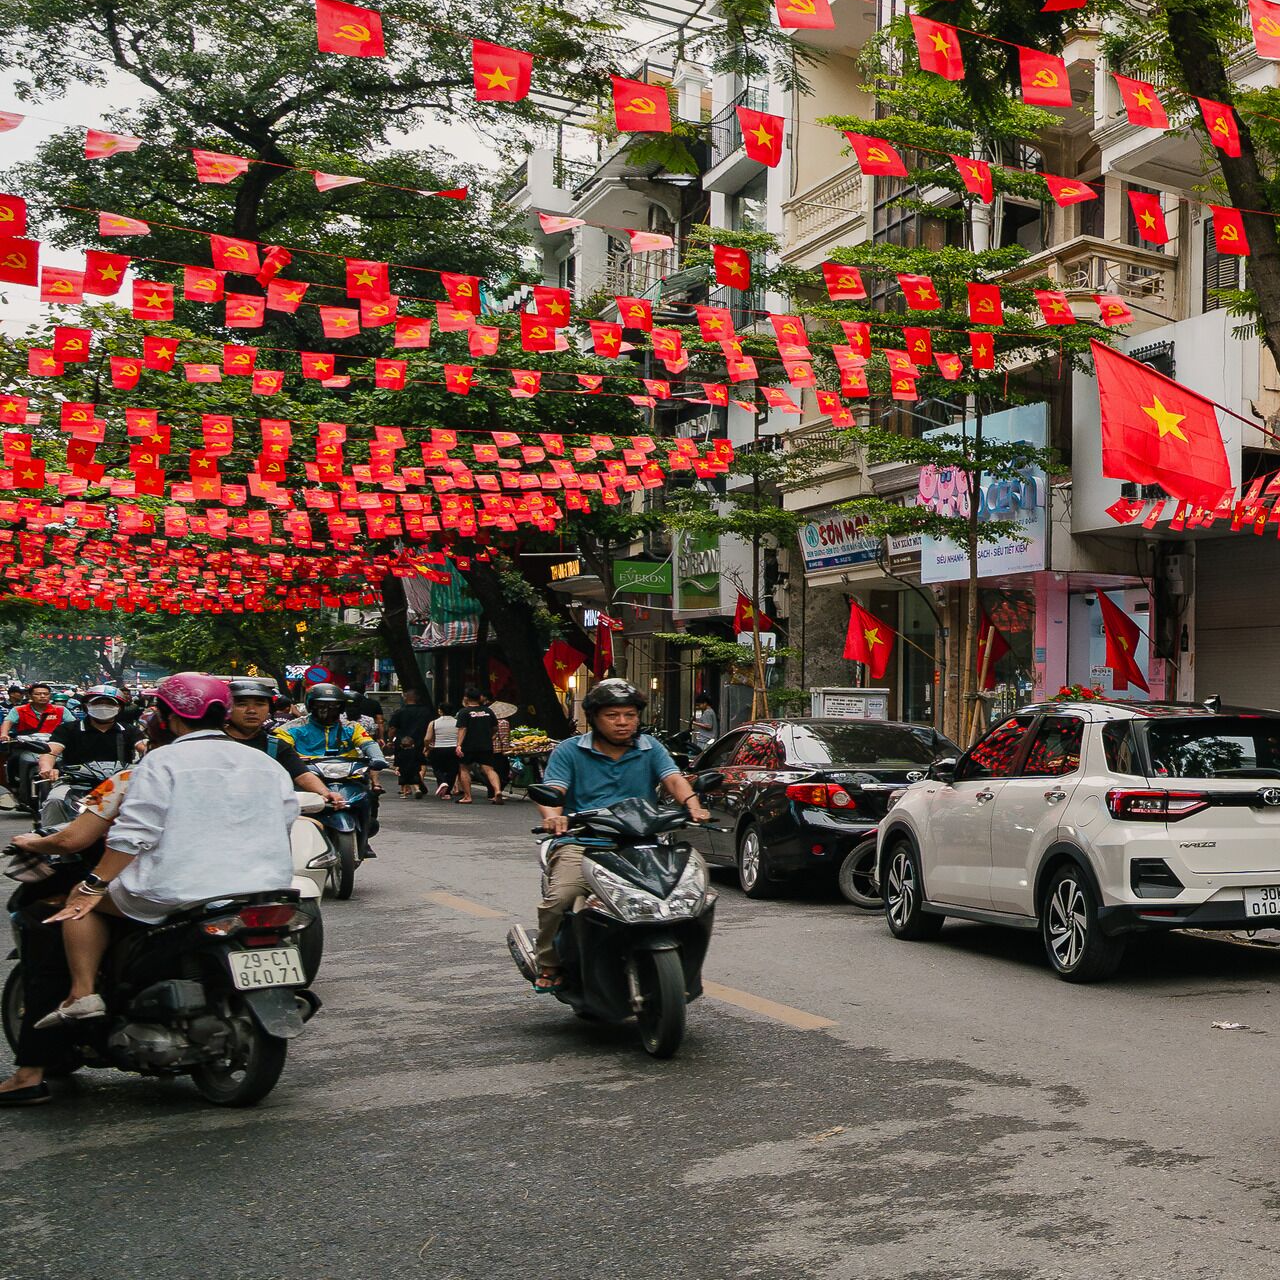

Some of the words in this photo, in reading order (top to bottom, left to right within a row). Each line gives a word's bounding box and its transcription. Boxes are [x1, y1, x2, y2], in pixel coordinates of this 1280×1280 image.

[947, 552, 964, 564] NHANH
[619, 573, 666, 584] EVERON
[241, 951, 290, 969] 29-C1
[240, 967, 300, 987] 840.71
